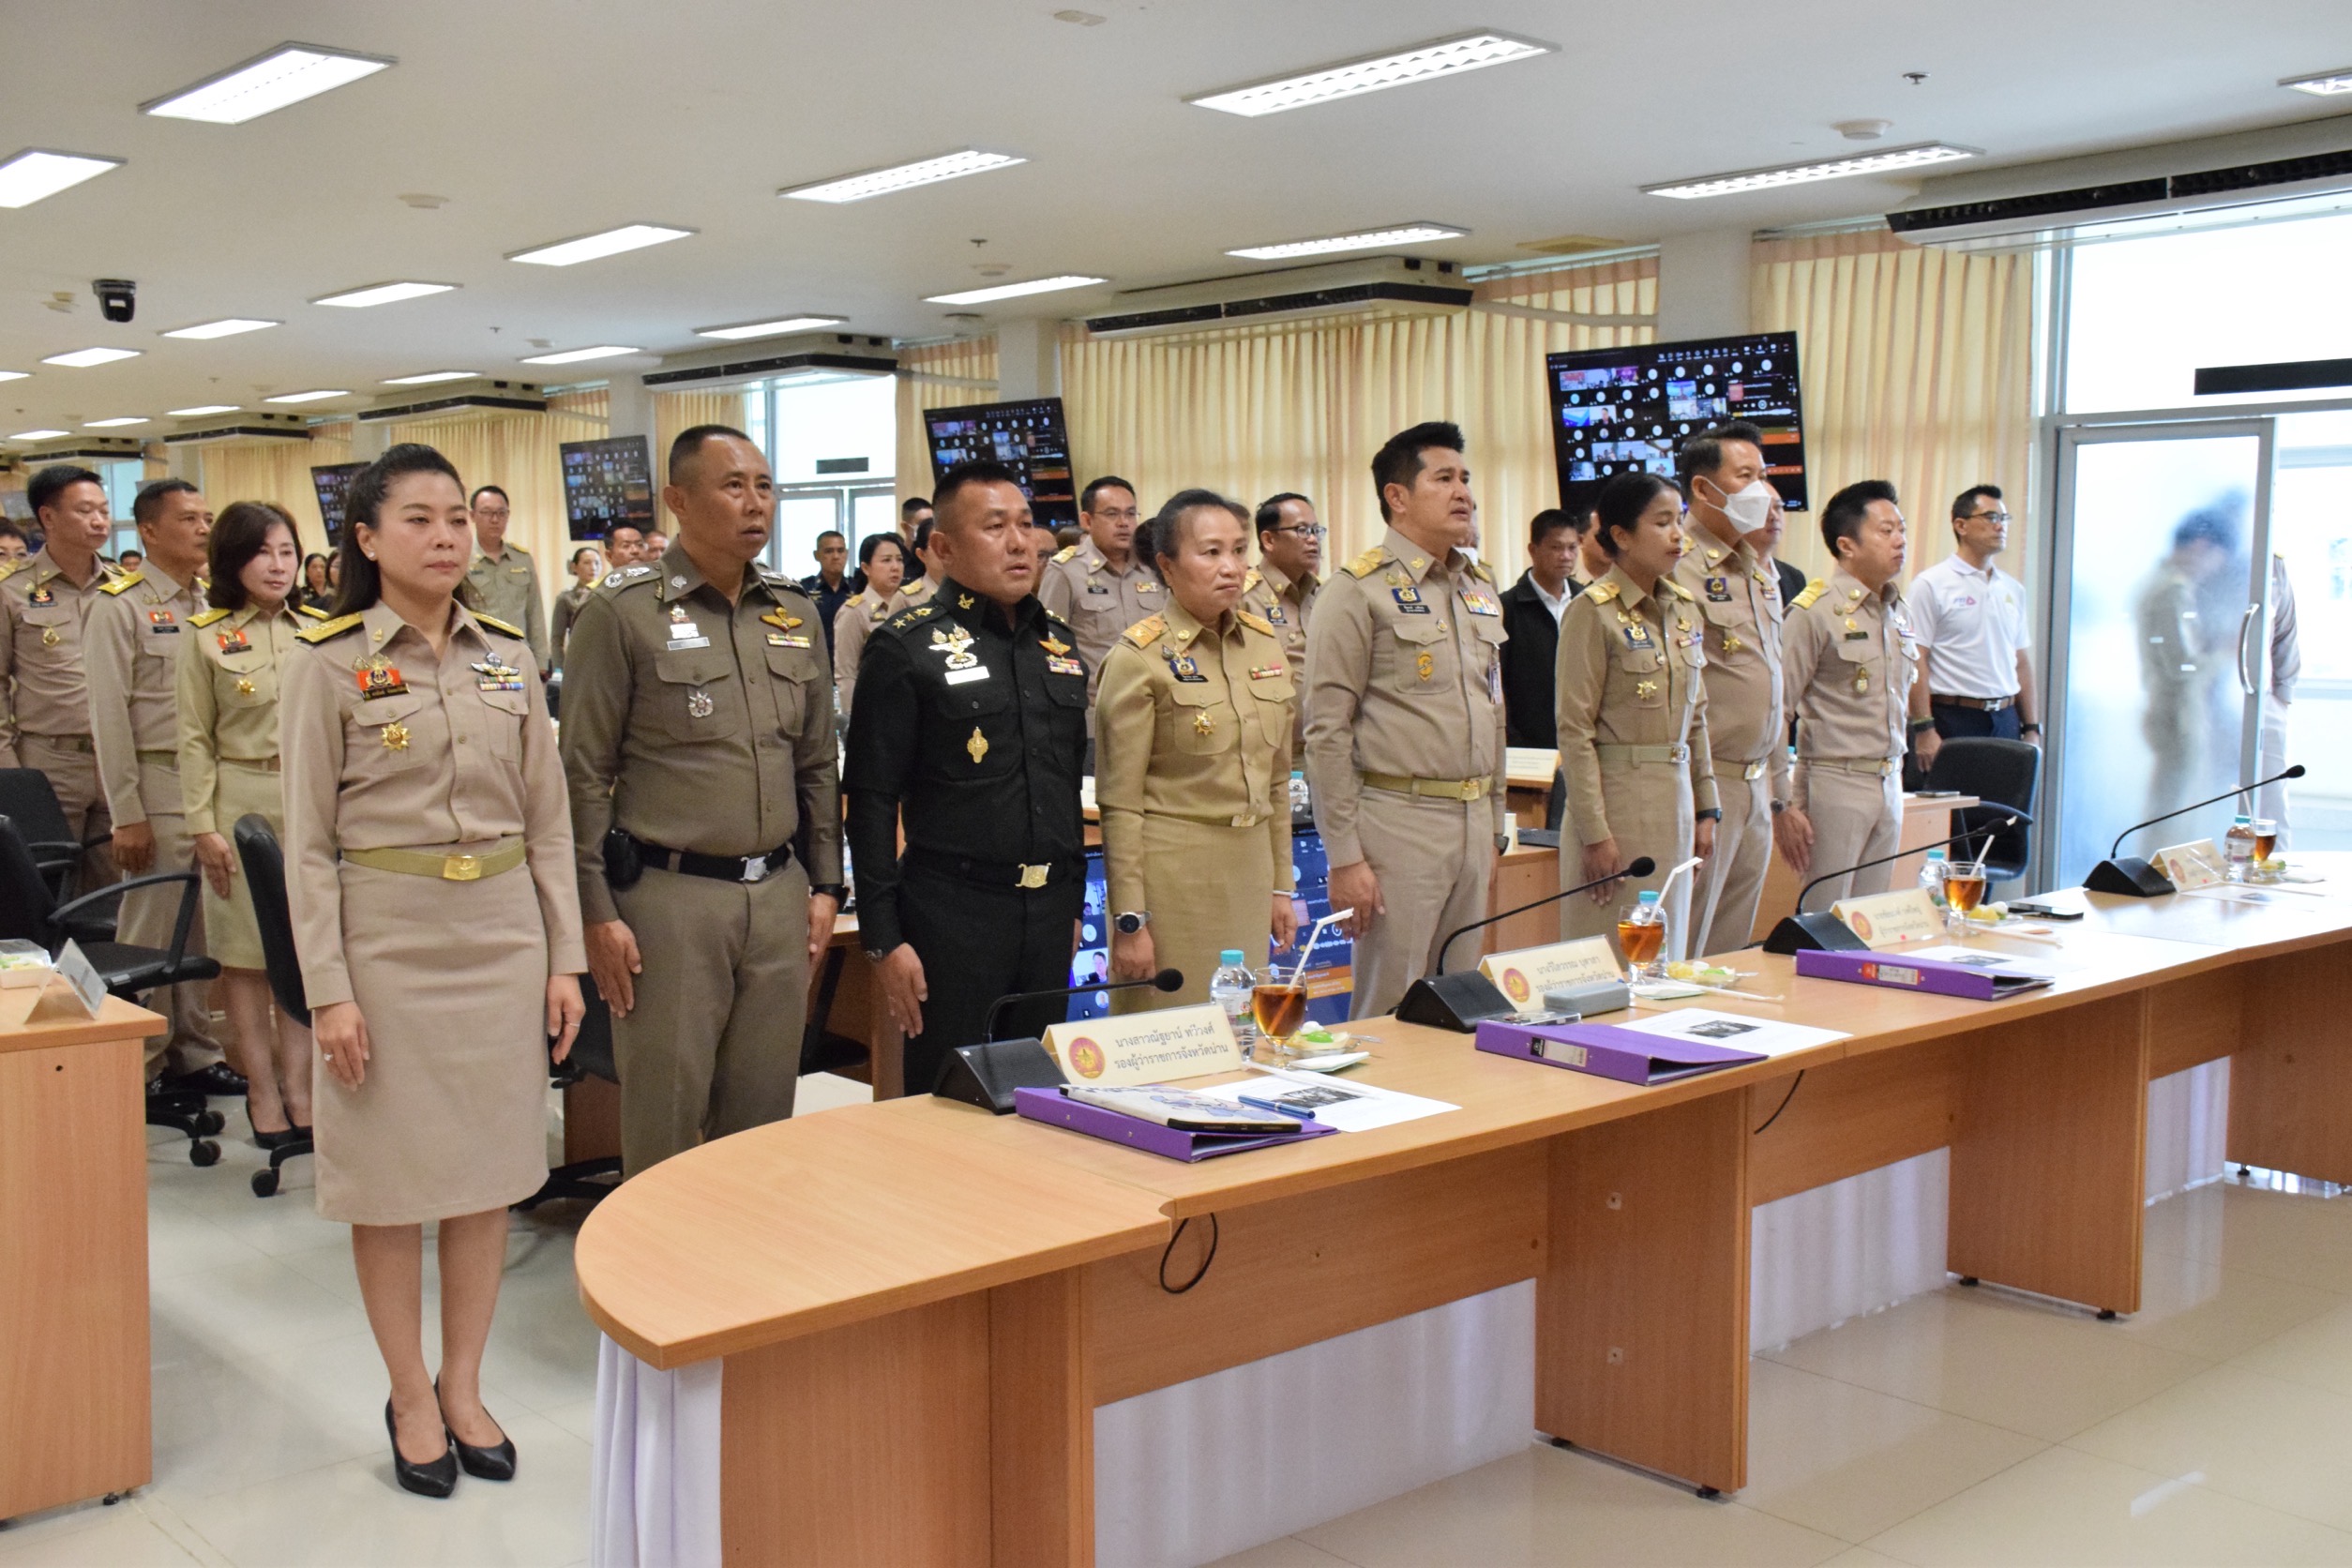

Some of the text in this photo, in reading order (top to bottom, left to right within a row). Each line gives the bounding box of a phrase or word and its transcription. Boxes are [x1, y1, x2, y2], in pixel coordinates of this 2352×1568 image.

[1537, 971, 1615, 992] รองผ้ว่าราชการจังหวัดน่าน
[1114, 1043, 1229, 1070] รองผู้ว่าราชการจังหวัดน่าน
